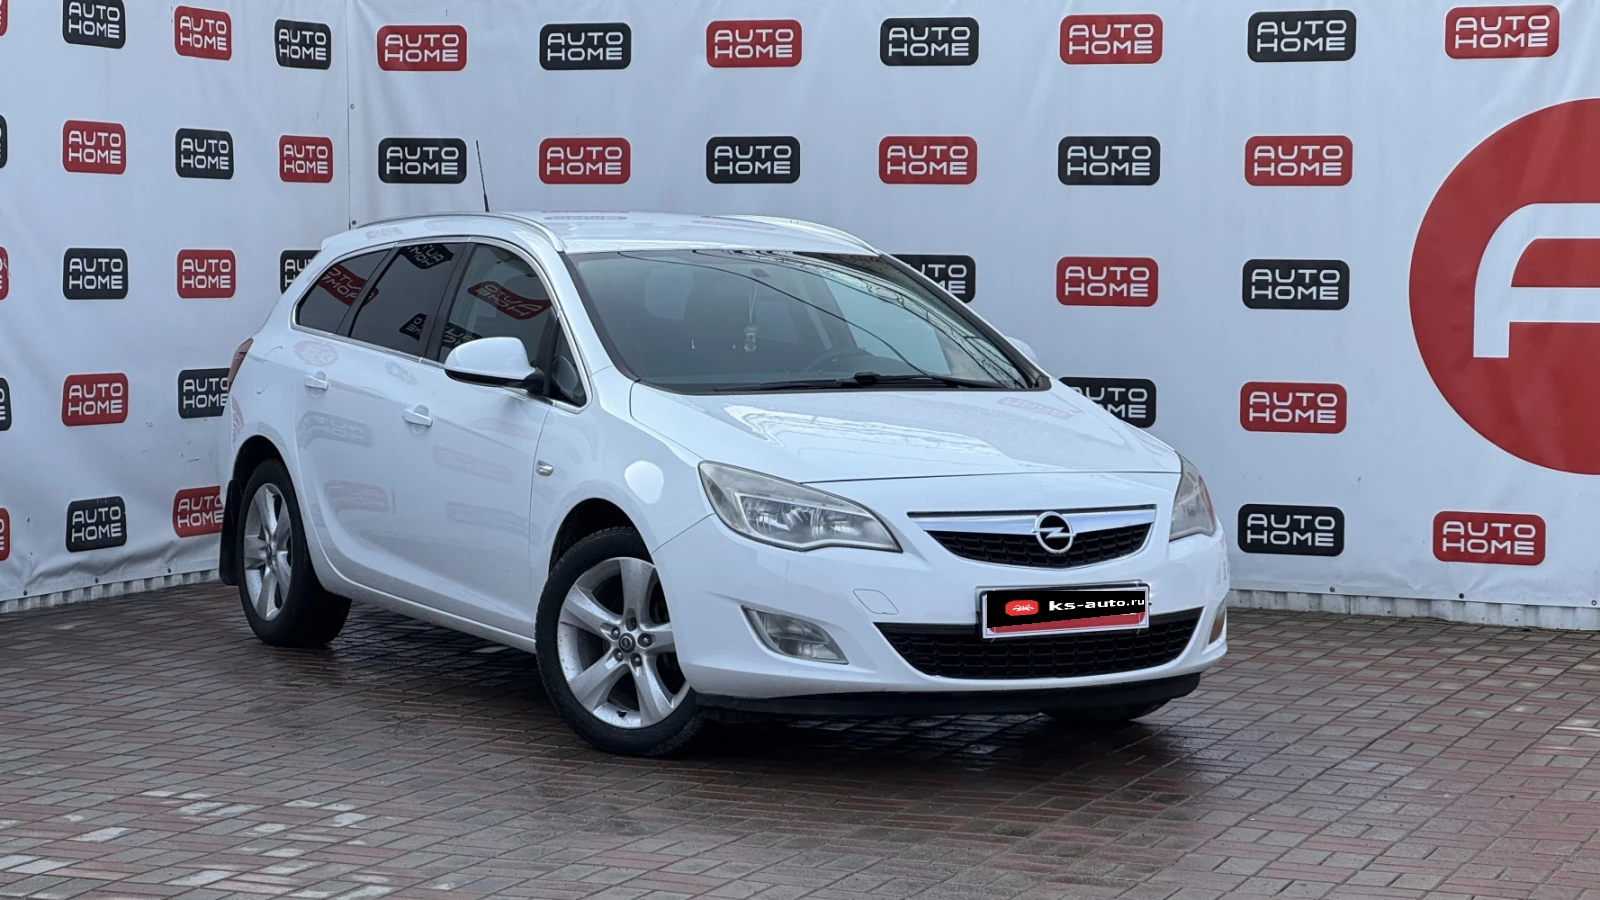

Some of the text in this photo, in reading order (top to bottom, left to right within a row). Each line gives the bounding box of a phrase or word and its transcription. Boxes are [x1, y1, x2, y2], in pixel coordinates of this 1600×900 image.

[69, 2, 120, 21] AUTO
[69, 19, 119, 38] HOME
[180, 16, 226, 34] AUTO
[1258, 20, 1346, 35] AUTO
[1456, 15, 1550, 31] AUTO
[279, 29, 326, 45] AUTO
[715, 29, 793, 42] AUTO
[889, 27, 970, 40] AUTO
[1070, 24, 1153, 38] AUTO
[181, 33, 226, 50] HOME
[385, 34, 459, 46] AUTO
[548, 32, 623, 45] AUTO
[1257, 37, 1345, 52] HOME
[1455, 33, 1548, 48] HOME
[279, 45, 326, 60] HOME
[715, 45, 792, 58] HOME
[889, 43, 968, 56] HOME
[1069, 40, 1152, 54] HOME
[385, 50, 458, 62] HOME
[548, 48, 622, 60] HOME
[69, 131, 121, 147] AUTO
[182, 139, 228, 153] AUTO
[284, 145, 327, 158] AUTO
[715, 146, 791, 158] AUTO
[888, 146, 968, 158] AUTO
[1068, 146, 1151, 159] AUTO
[1255, 146, 1343, 159] AUTO
[69, 148, 120, 164] HOME
[387, 147, 458, 159] AUTO
[547, 147, 622, 159] AUTO
[182, 155, 228, 169] HOME
[285, 161, 327, 173] HOME
[387, 162, 457, 174] HOME
[547, 163, 621, 174] HOME
[715, 162, 790, 174] HOME
[888, 162, 967, 174] HOME
[1068, 162, 1150, 175] HOME
[1254, 163, 1341, 176] HOME
[70, 259, 122, 272] AUTO
[183, 259, 230, 272] AUTO
[285, 259, 313, 272] AU
[1066, 267, 1149, 280] AUTO
[1252, 269, 1340, 283] AUTO
[70, 276, 122, 289] HOME
[183, 276, 230, 288] HOME
[1066, 283, 1148, 296] HOME
[1252, 286, 1338, 300] HOME
[70, 383, 122, 398] AUTO
[1250, 392, 1337, 406] AUTO
[69, 400, 122, 415] HOME
[1097, 404, 1146, 418] ME
[1250, 408, 1335, 423] HOME
[73, 506, 121, 526] AUTO
[1248, 514, 1334, 529] AUTO
[72, 522, 122, 542] HOME
[1443, 522, 1535, 538] AUTO
[1248, 530, 1333, 546] HOME
[1443, 538, 1534, 555] HOME
